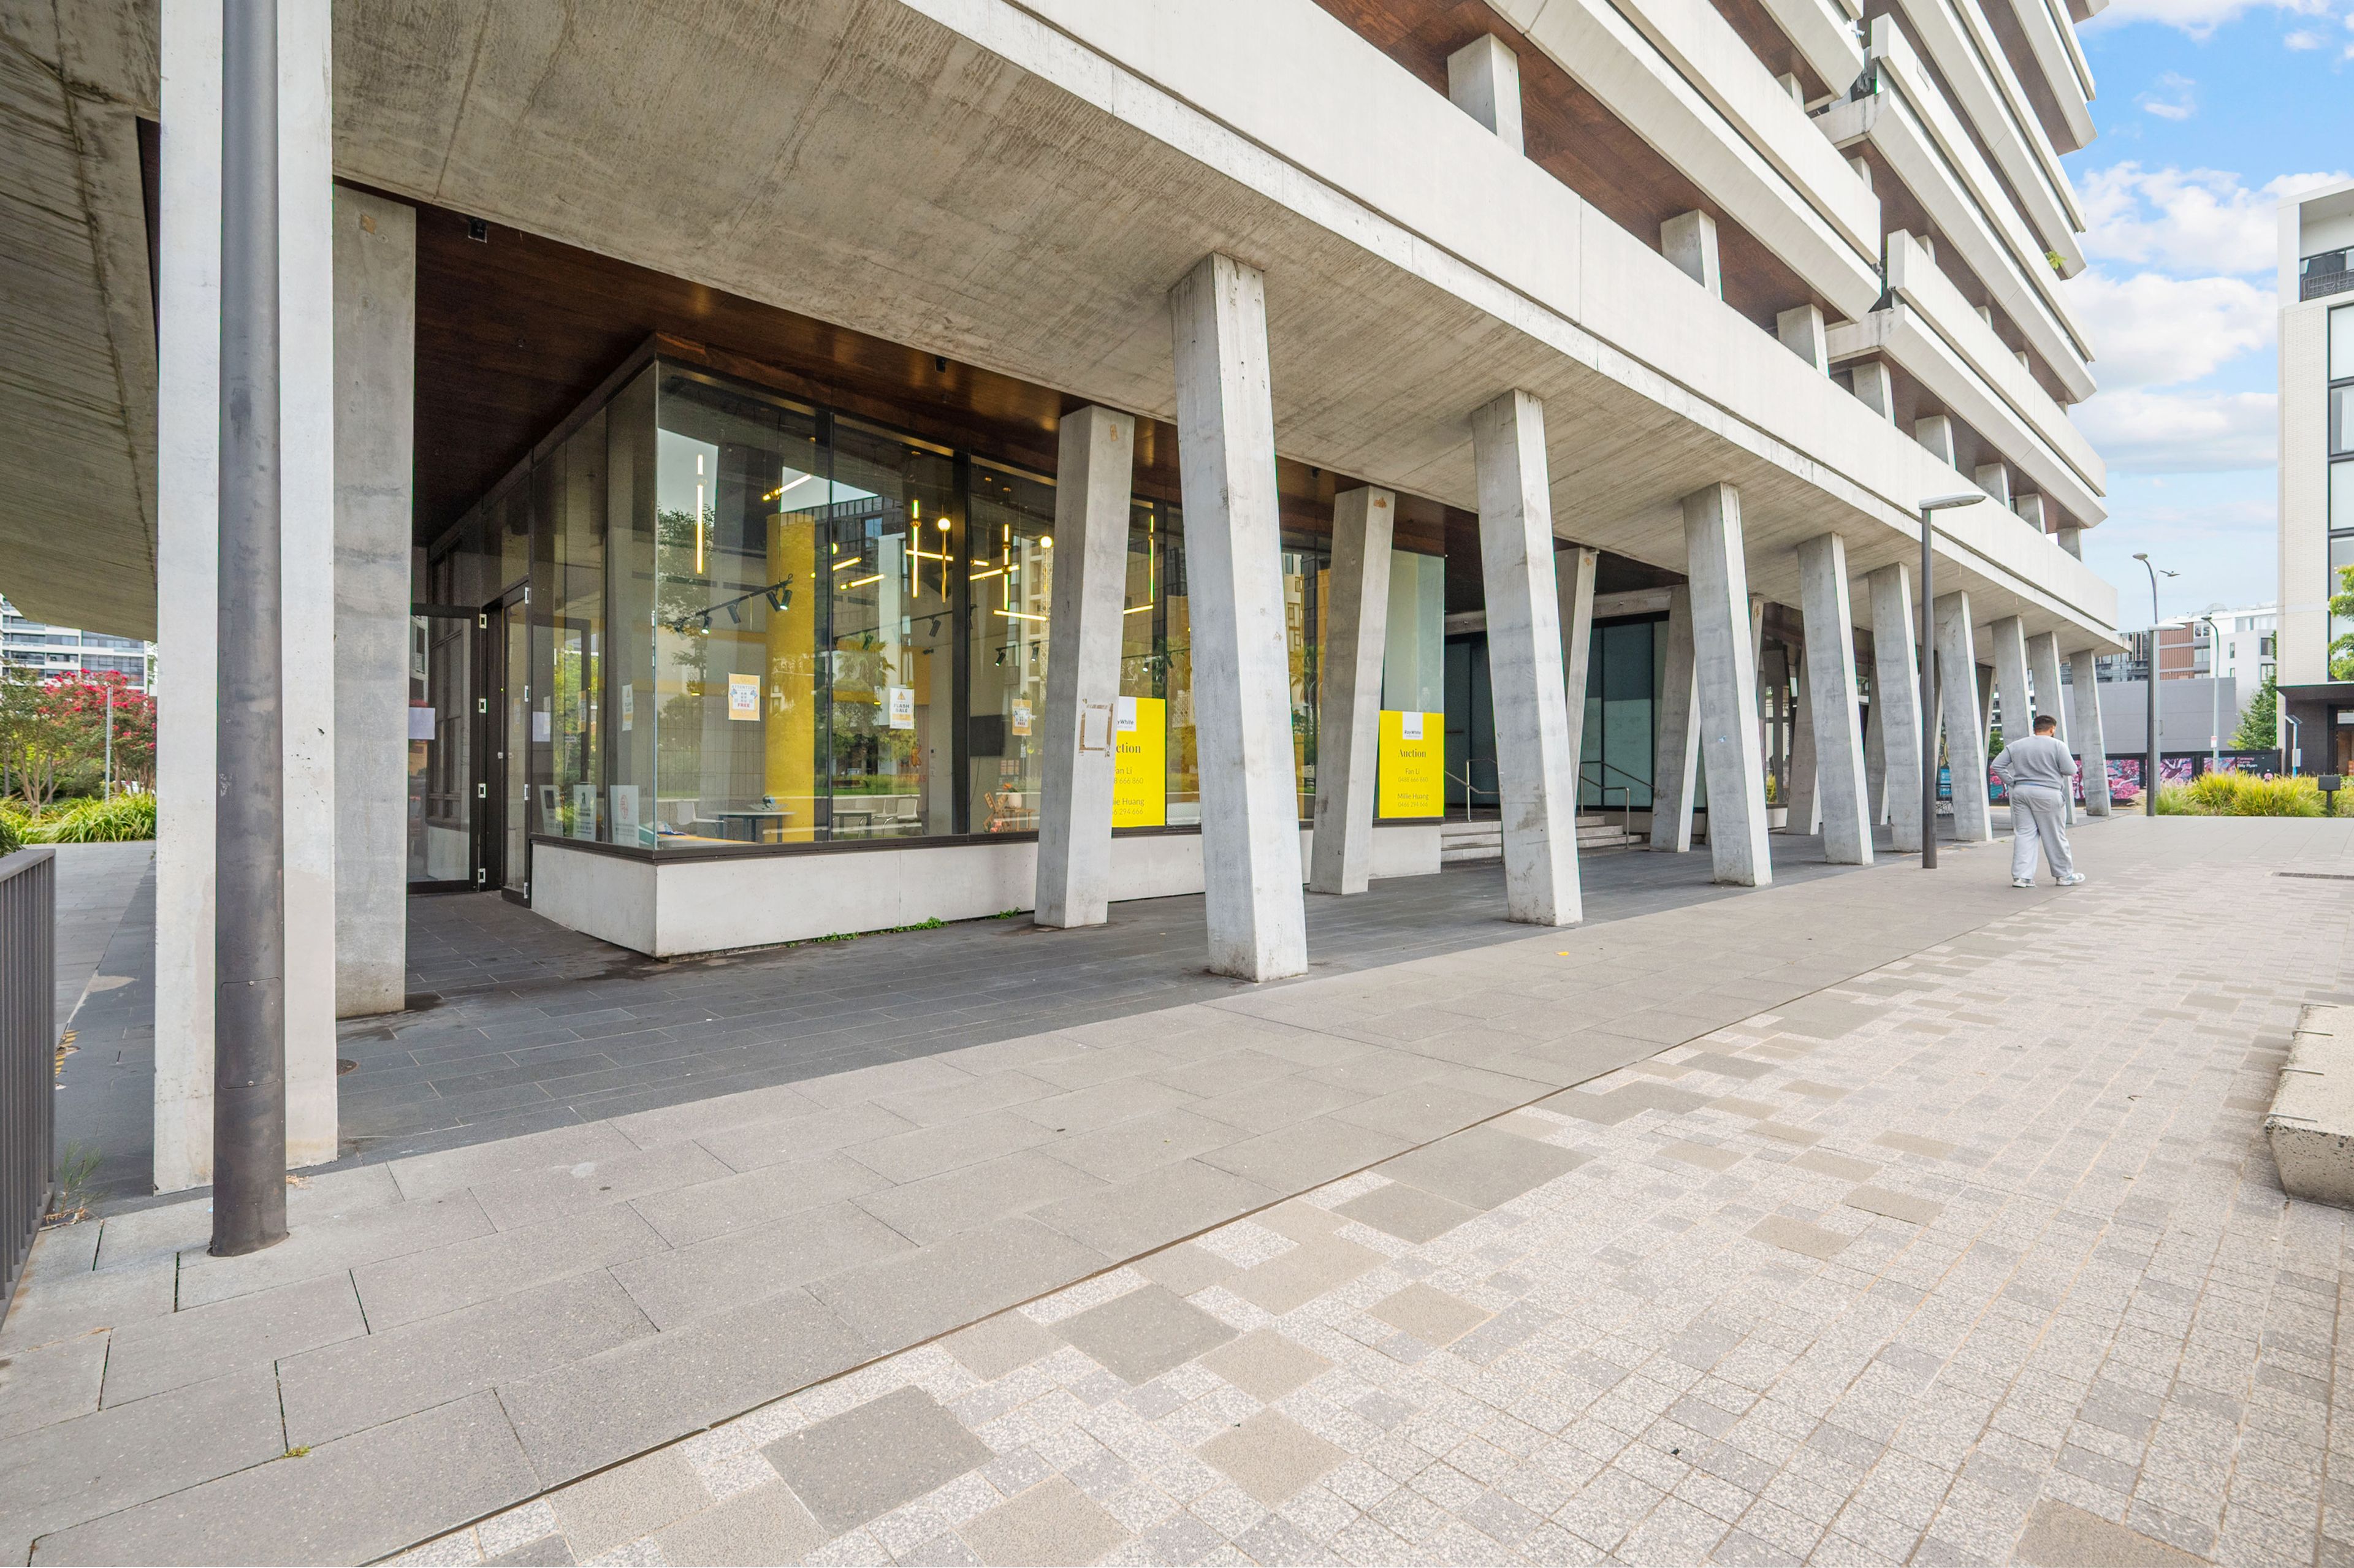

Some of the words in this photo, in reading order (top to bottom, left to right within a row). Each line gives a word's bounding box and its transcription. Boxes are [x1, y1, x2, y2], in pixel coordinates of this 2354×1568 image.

[1116, 742, 1141, 753] ction
[1398, 748, 1426, 758] Auction
[1122, 797, 1145, 807] Huang
